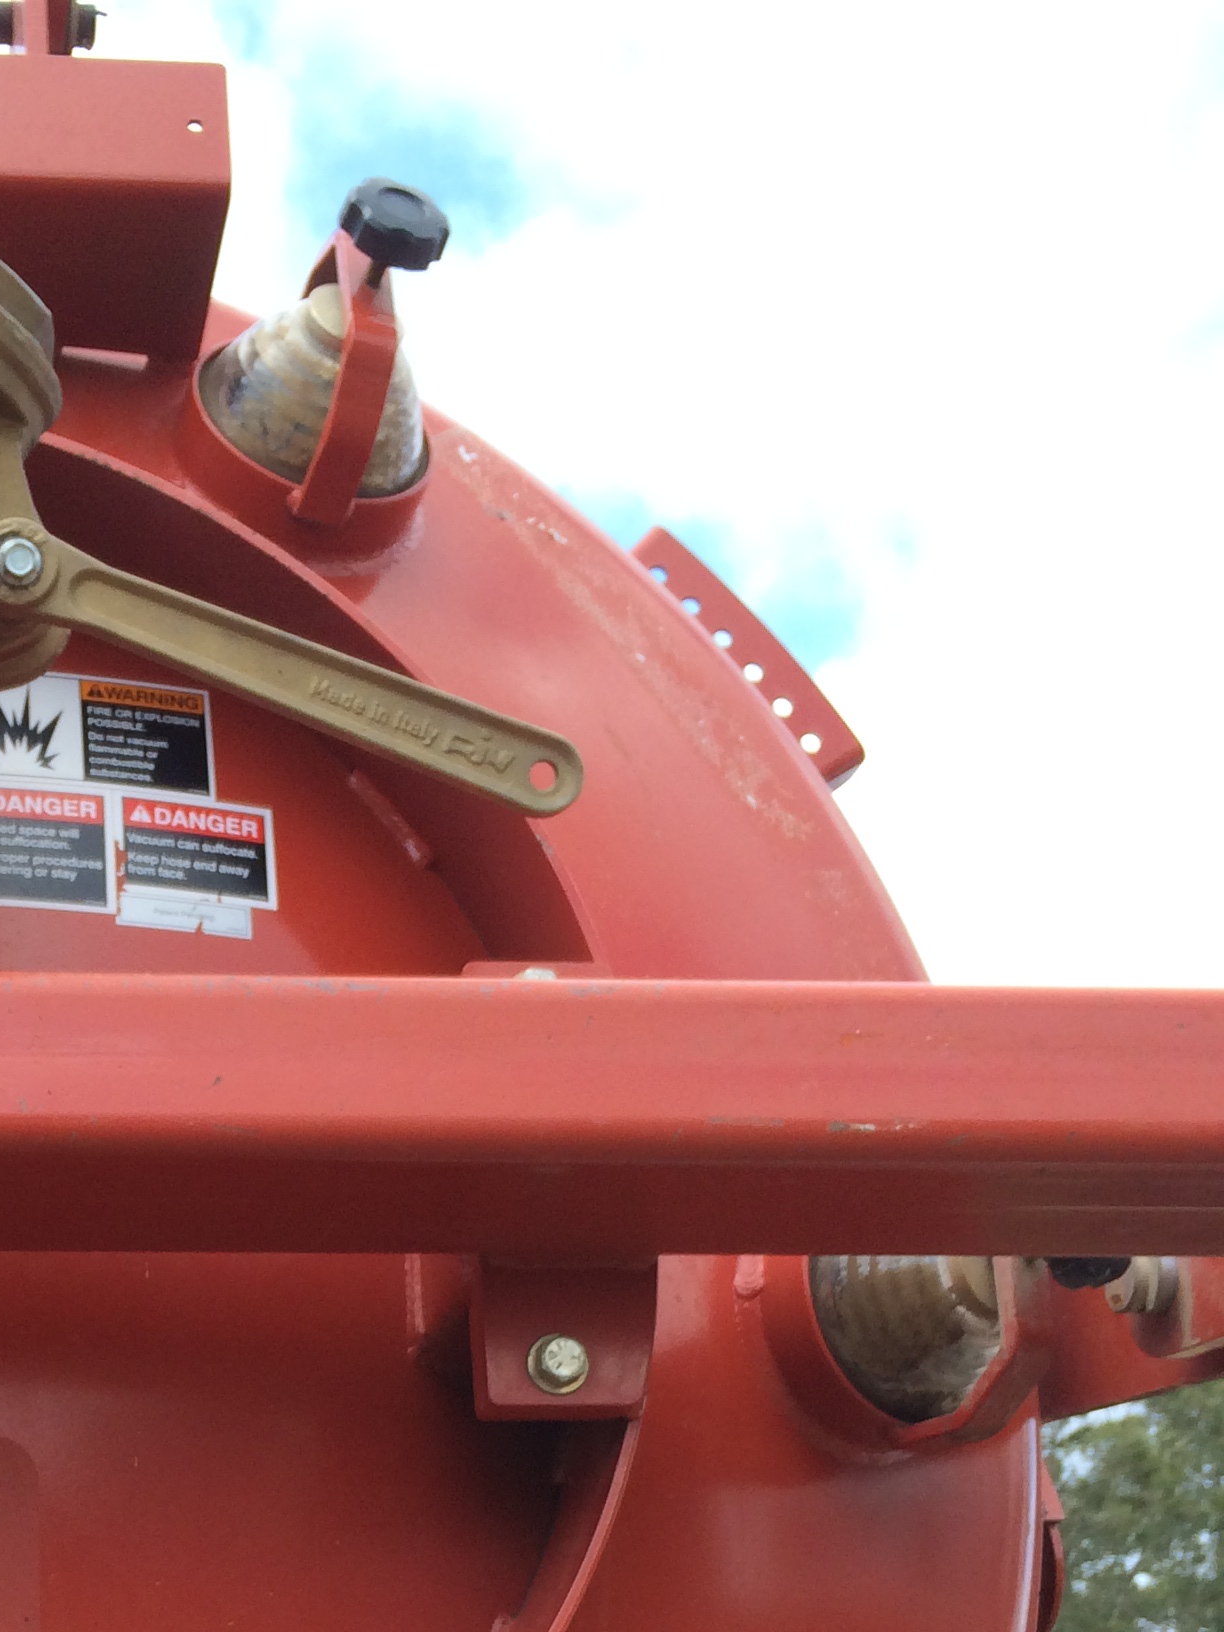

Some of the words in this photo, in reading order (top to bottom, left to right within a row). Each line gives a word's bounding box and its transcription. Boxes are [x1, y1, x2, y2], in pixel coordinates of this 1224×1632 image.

[104, 686, 199, 710] WARNING
[87, 705, 113, 717] FIRE
[115, 709, 133, 719] OR
[134, 711, 200, 728] EXPLOSION
[310, 676, 366, 715] Made
[368, 703, 390, 725] in
[394, 710, 440, 748] Italy
[87, 731, 105, 741] Do
[106, 735, 124, 743] not
[126, 737, 169, 749] vacuum
[89, 756, 155, 770] combustible
[146, 751, 158, 759] or
[153, 807, 259, 839] DANGER
[18, 826, 56, 838] space
[58, 828, 80, 839] will
[0, 837, 72, 850] suffocation.
[126, 832, 176, 848] Vacuum
[177, 839, 200, 851] can
[201, 843, 258, 860] suffocate.
[32, 857, 104, 871] procedures
[127, 852, 159, 866] Keep
[160, 855, 192, 869] hose
[193, 860, 217, 873] end
[218, 864, 250, 879] away
[127, 863, 156, 877] from
[157, 866, 187, 880] face.
[34, 868, 48, 877] or
[51, 869, 78, 882] stay
